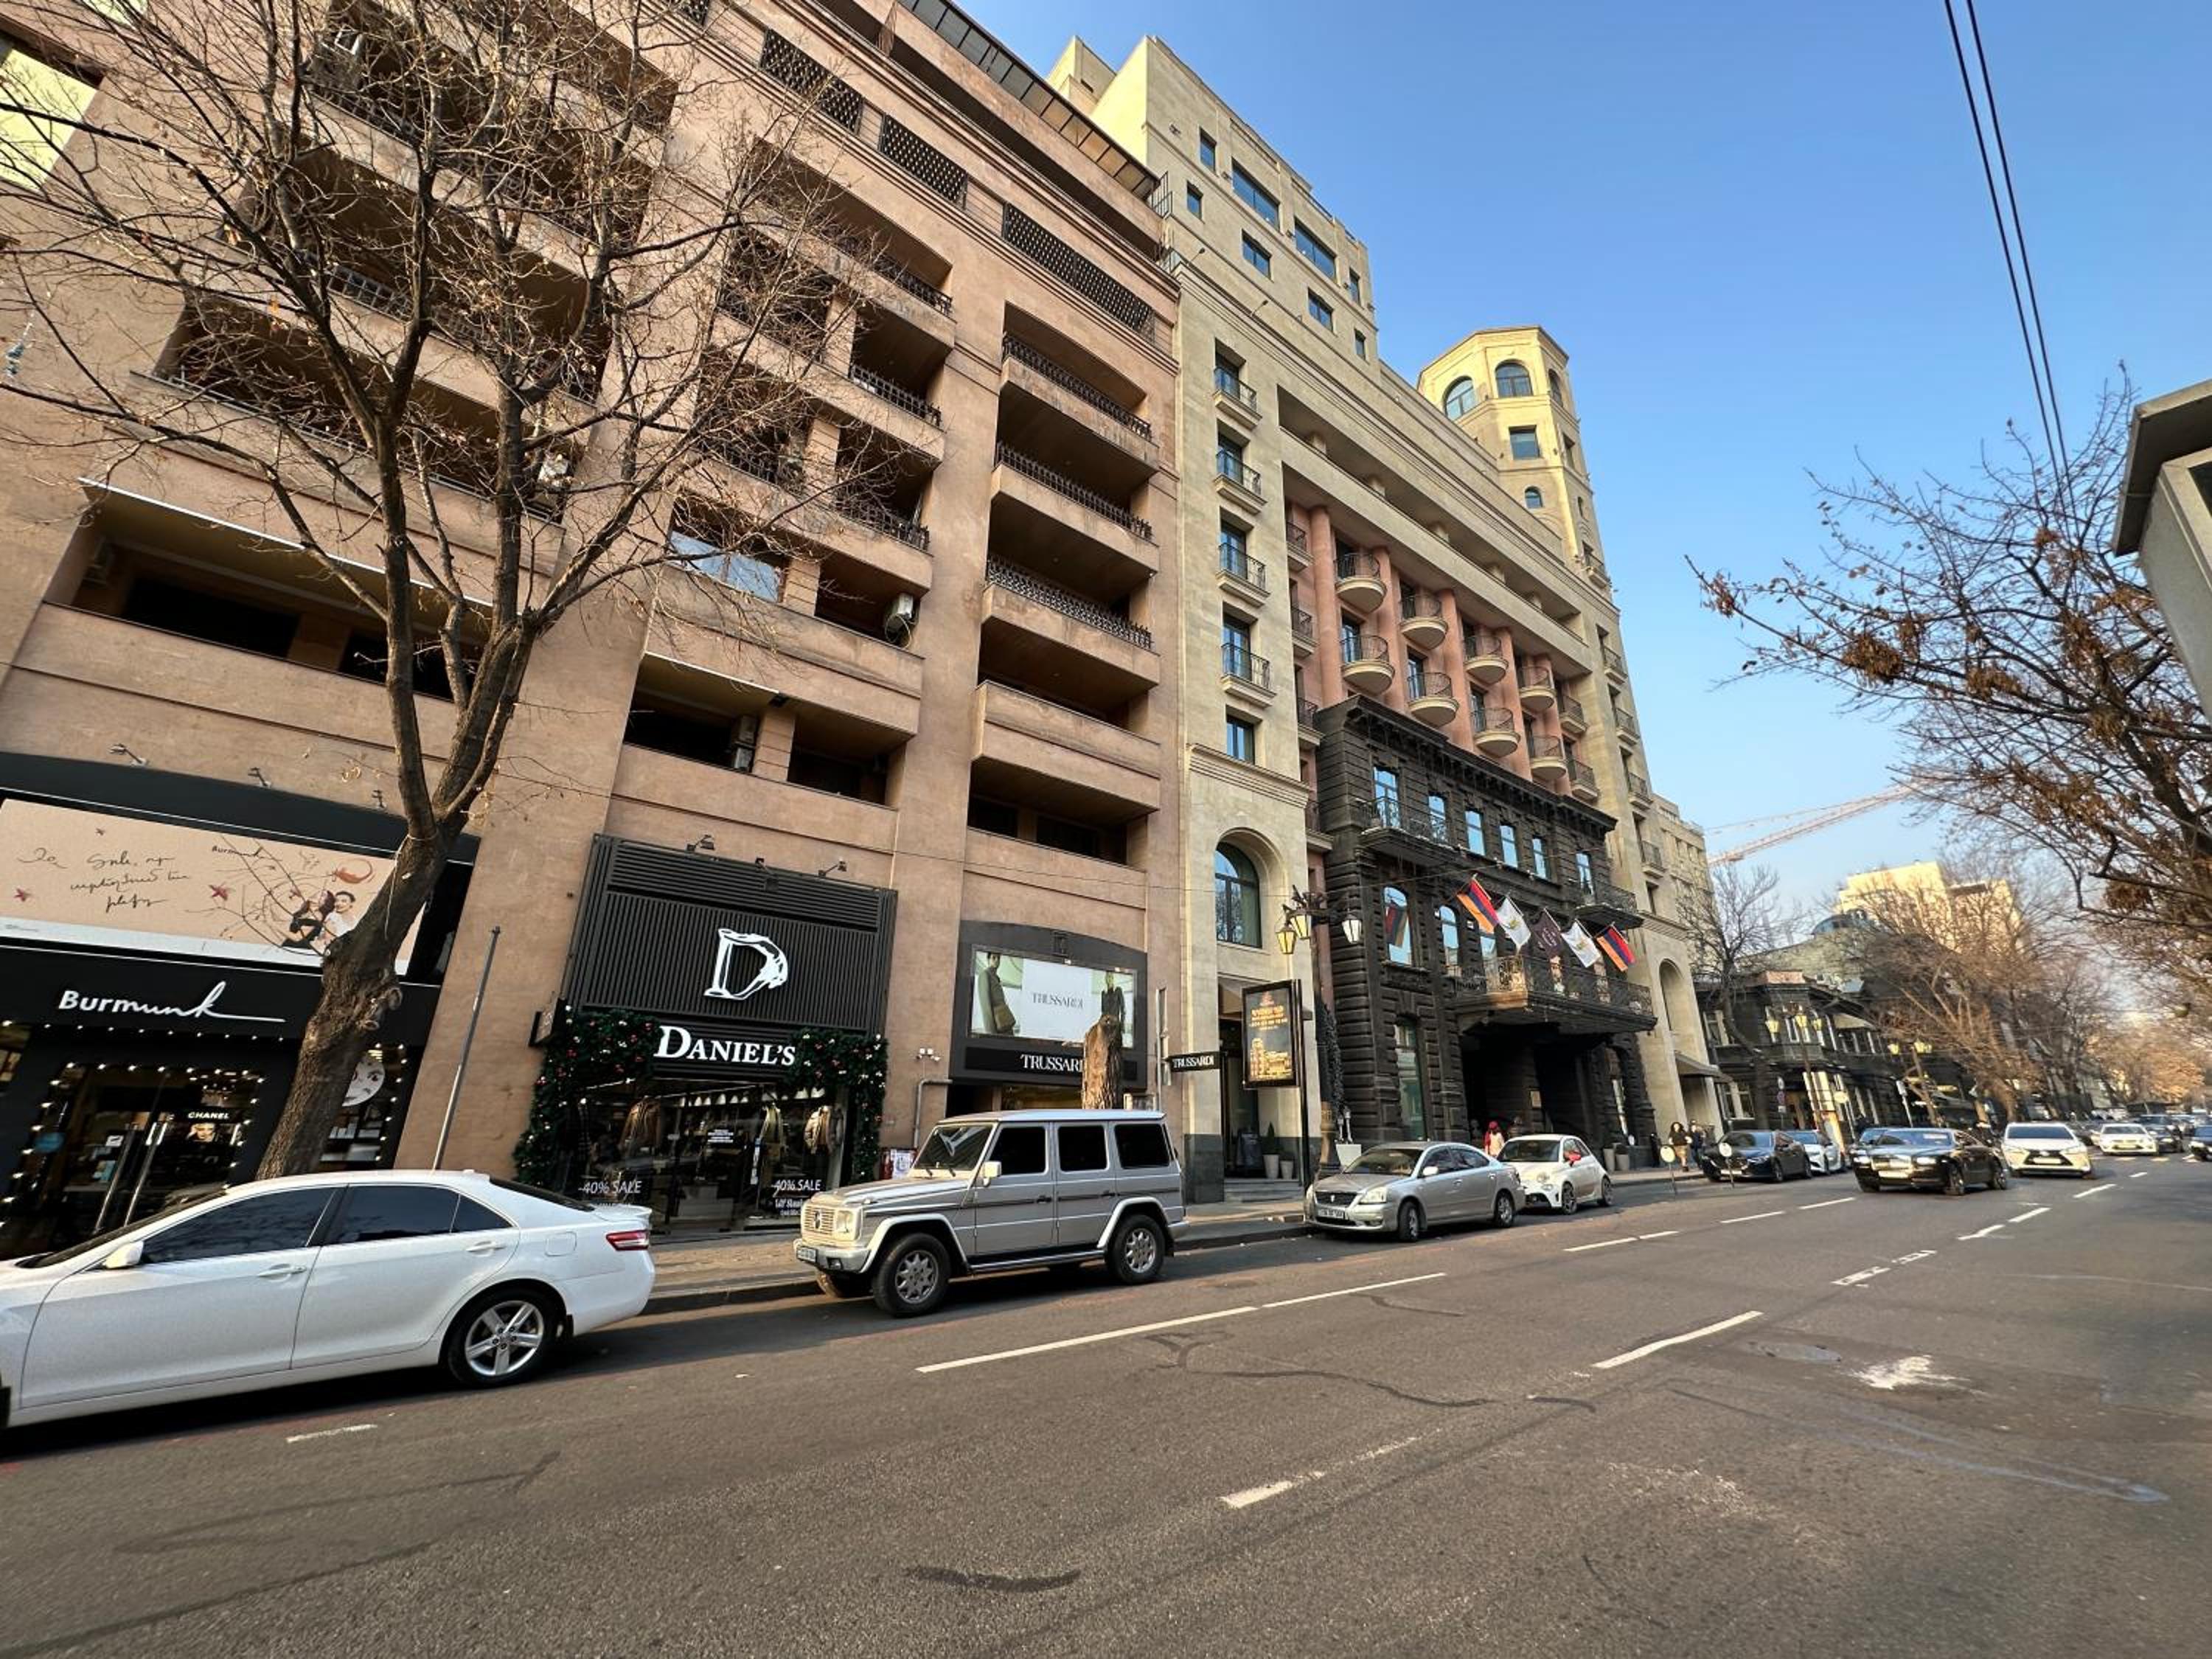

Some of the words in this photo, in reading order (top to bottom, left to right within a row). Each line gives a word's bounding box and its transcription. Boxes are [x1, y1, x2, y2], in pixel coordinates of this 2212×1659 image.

[58, 981, 286, 1023] Burmunk
[187, 1111, 230, 1120] CHANEL
[612, 1180, 642, 1194] SALE
[798, 1179, 822, 1192] SALE
